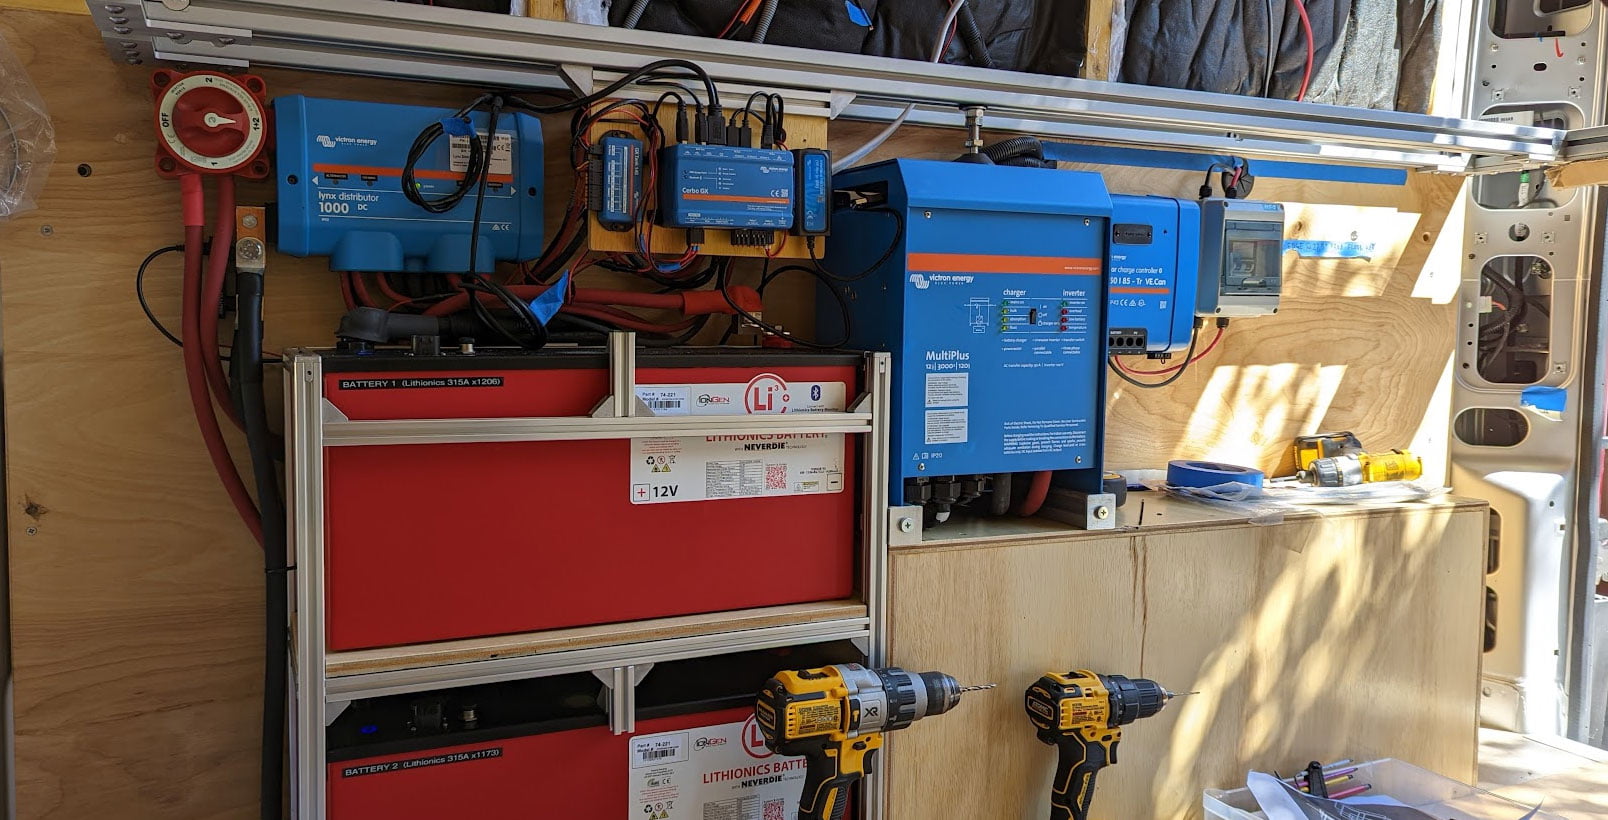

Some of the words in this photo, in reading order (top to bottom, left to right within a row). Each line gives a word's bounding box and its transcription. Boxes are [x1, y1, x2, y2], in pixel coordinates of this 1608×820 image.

[162, 112, 170, 128] OFF
[319, 192, 336, 200] lynx
[338, 192, 379, 201] distributor
[319, 202, 349, 214] 1000
[1003, 289, 1026, 297] charger
[926, 350, 969, 361] MultiPlus
[402, 379, 445, 387] (Lithionics
[744, 442, 786, 451] NEVERDIE
[652, 485, 678, 497] 12V
[864, 707, 878, 718] XR
[345, 764, 390, 776] BATTERY
[403, 757, 445, 768] (Lithionics
[447, 753, 469, 762] 315A
[471, 749, 499, 758] x1173)
[703, 764, 770, 783] LITHIONICS
[742, 775, 782, 788] NEVERDIE
